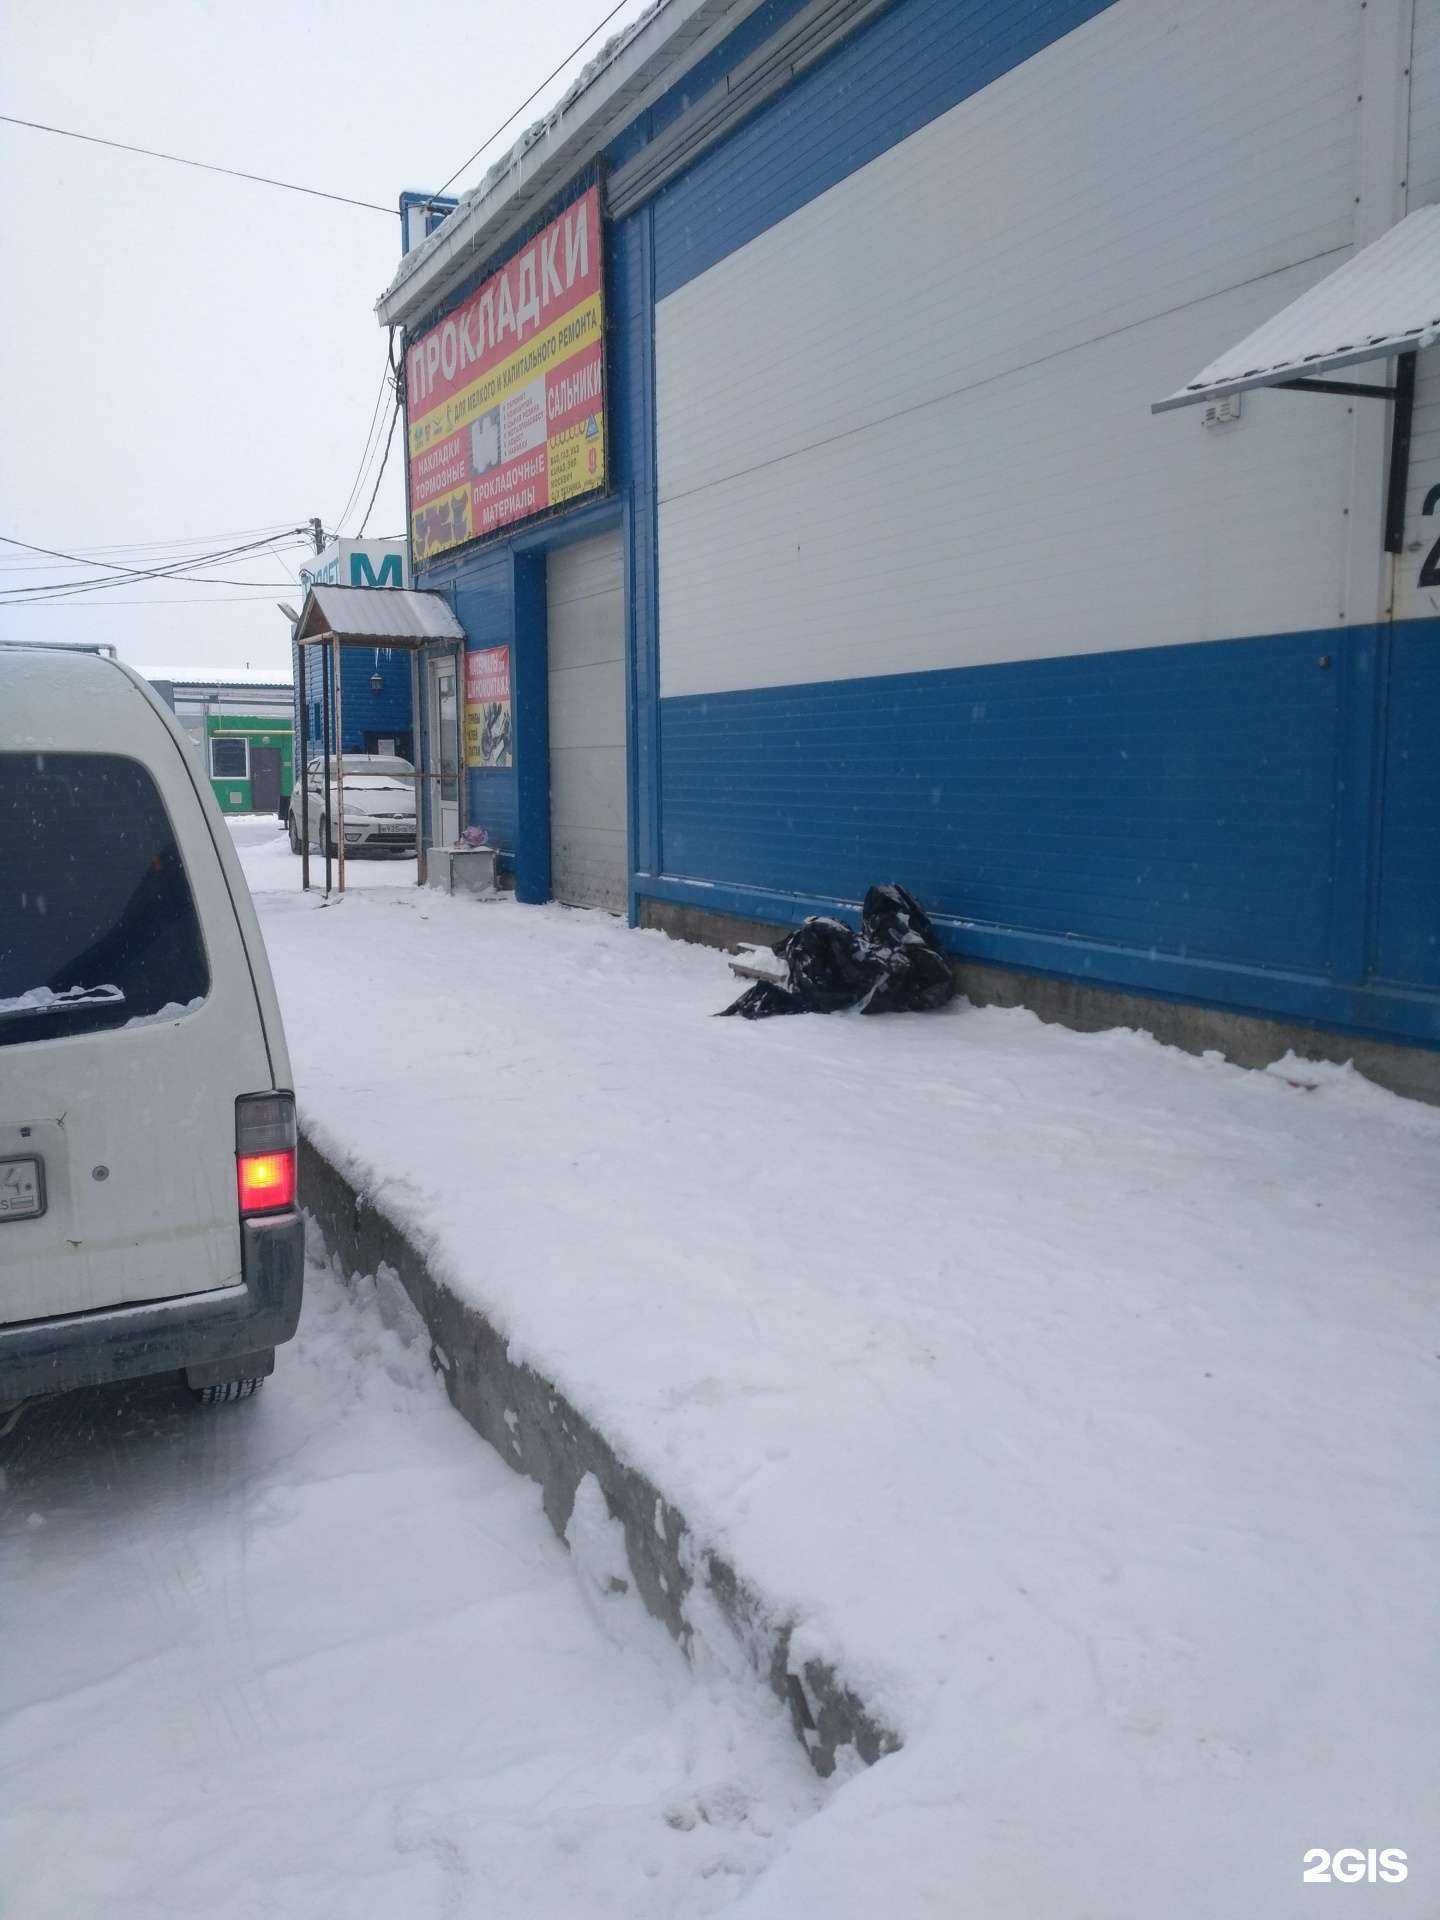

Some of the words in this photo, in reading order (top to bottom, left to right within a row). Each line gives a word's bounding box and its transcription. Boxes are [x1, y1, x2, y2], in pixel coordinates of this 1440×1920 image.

[412, 202, 589, 402] ПРОКЛАДКИ
[503, 336, 556, 388] КАПИТАЛЬНОГО
[558, 308, 598, 347] РЕМОНТА
[548, 360, 602, 420] САЛЬНИКИ
[416, 461, 465, 500] ТОРМОЗНЫЕ
[418, 438, 461, 476] НАКЛАДКИ
[474, 454, 544, 505] ПРОКЛАДОЧНЫЕ
[483, 486, 535, 525] МАТЕРИАЛЫ
